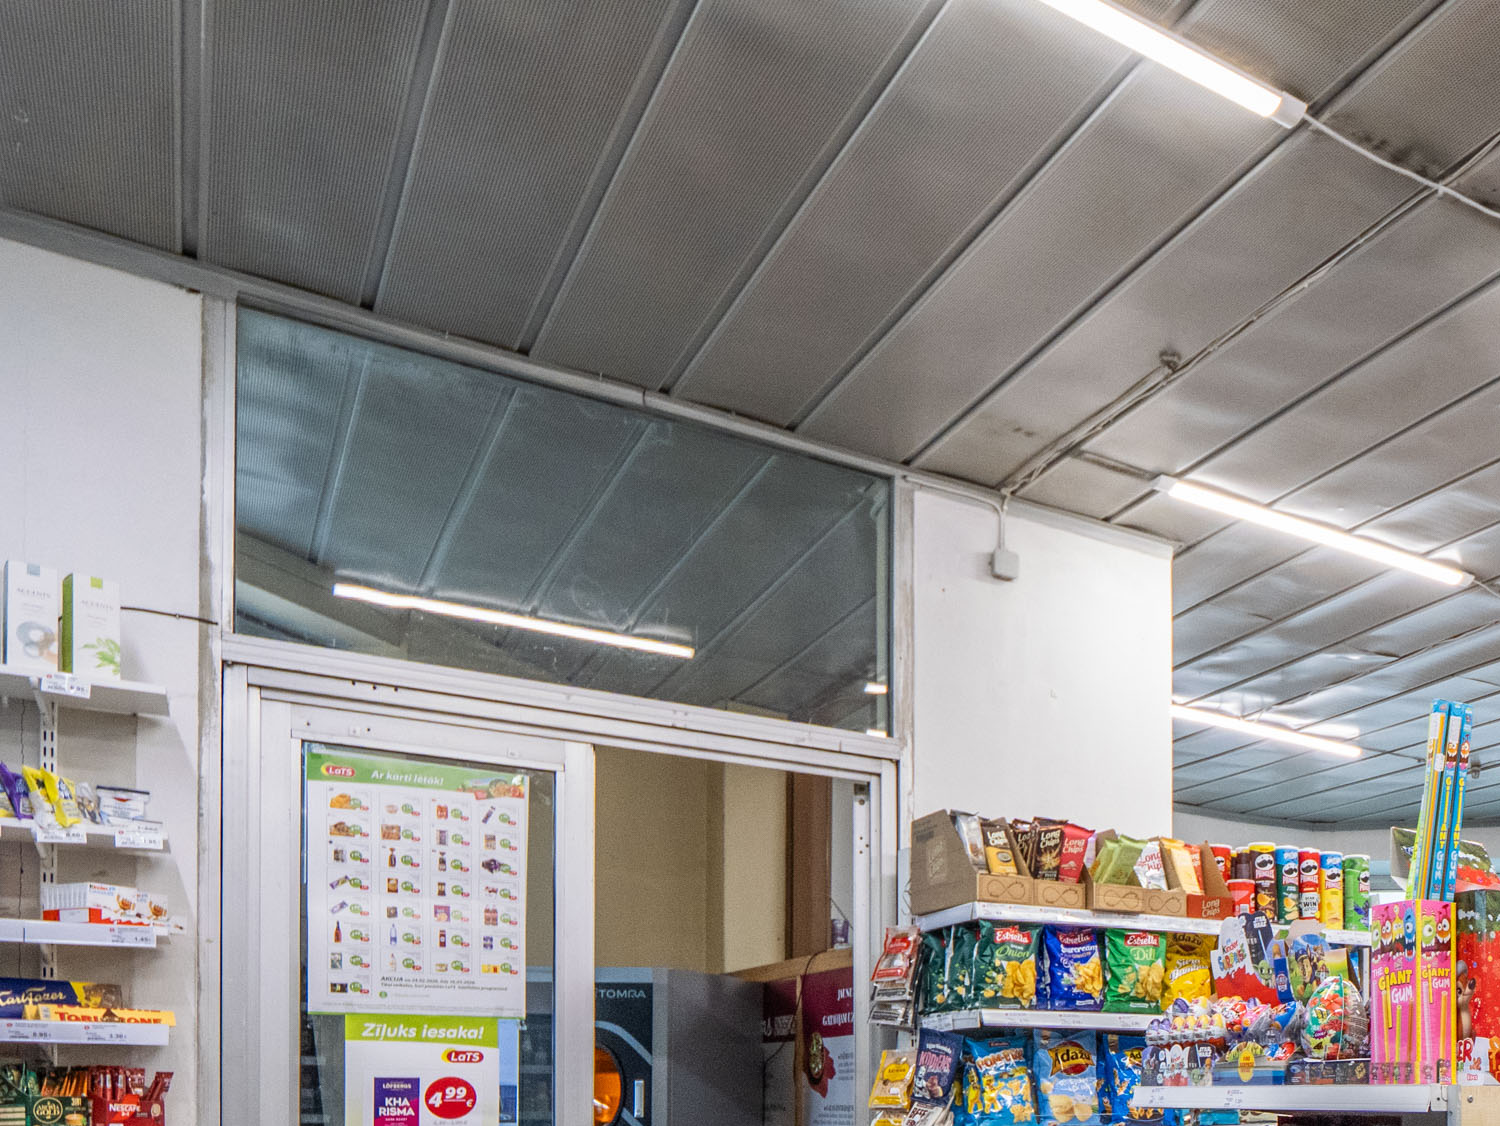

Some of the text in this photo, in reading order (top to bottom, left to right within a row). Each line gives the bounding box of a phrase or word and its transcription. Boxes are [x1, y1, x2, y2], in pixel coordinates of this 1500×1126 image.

[986, 829, 1006, 840] Long
[1040, 829, 1061, 841] Long
[1040, 837, 1060, 849] Chips
[1064, 837, 1086, 848] Long
[1434, 850, 1444, 880] GUM
[1448, 851, 1458, 880] GUM
[1201, 899, 1220, 910] Long
[995, 932, 1029, 944] Estrella
[1059, 933, 1091, 944] Estrella
[1126, 935, 1158, 946] Estrella
[1421, 964, 1451, 980] GIANT
[1378, 966, 1413, 991] GIANT
[1432, 977, 1451, 989] GUM
[600, 988, 646, 999] TOMRA
[1391, 985, 1413, 1003] GUM
[422, 1023, 484, 1039] iesaka!
[450, 1051, 481, 1063] LaTS
[385, 1097, 410, 1106] KHA
[428, 1092, 442, 1108] 4
[445, 1087, 467, 1099] 99
[378, 1107, 415, 1116] RISMA
